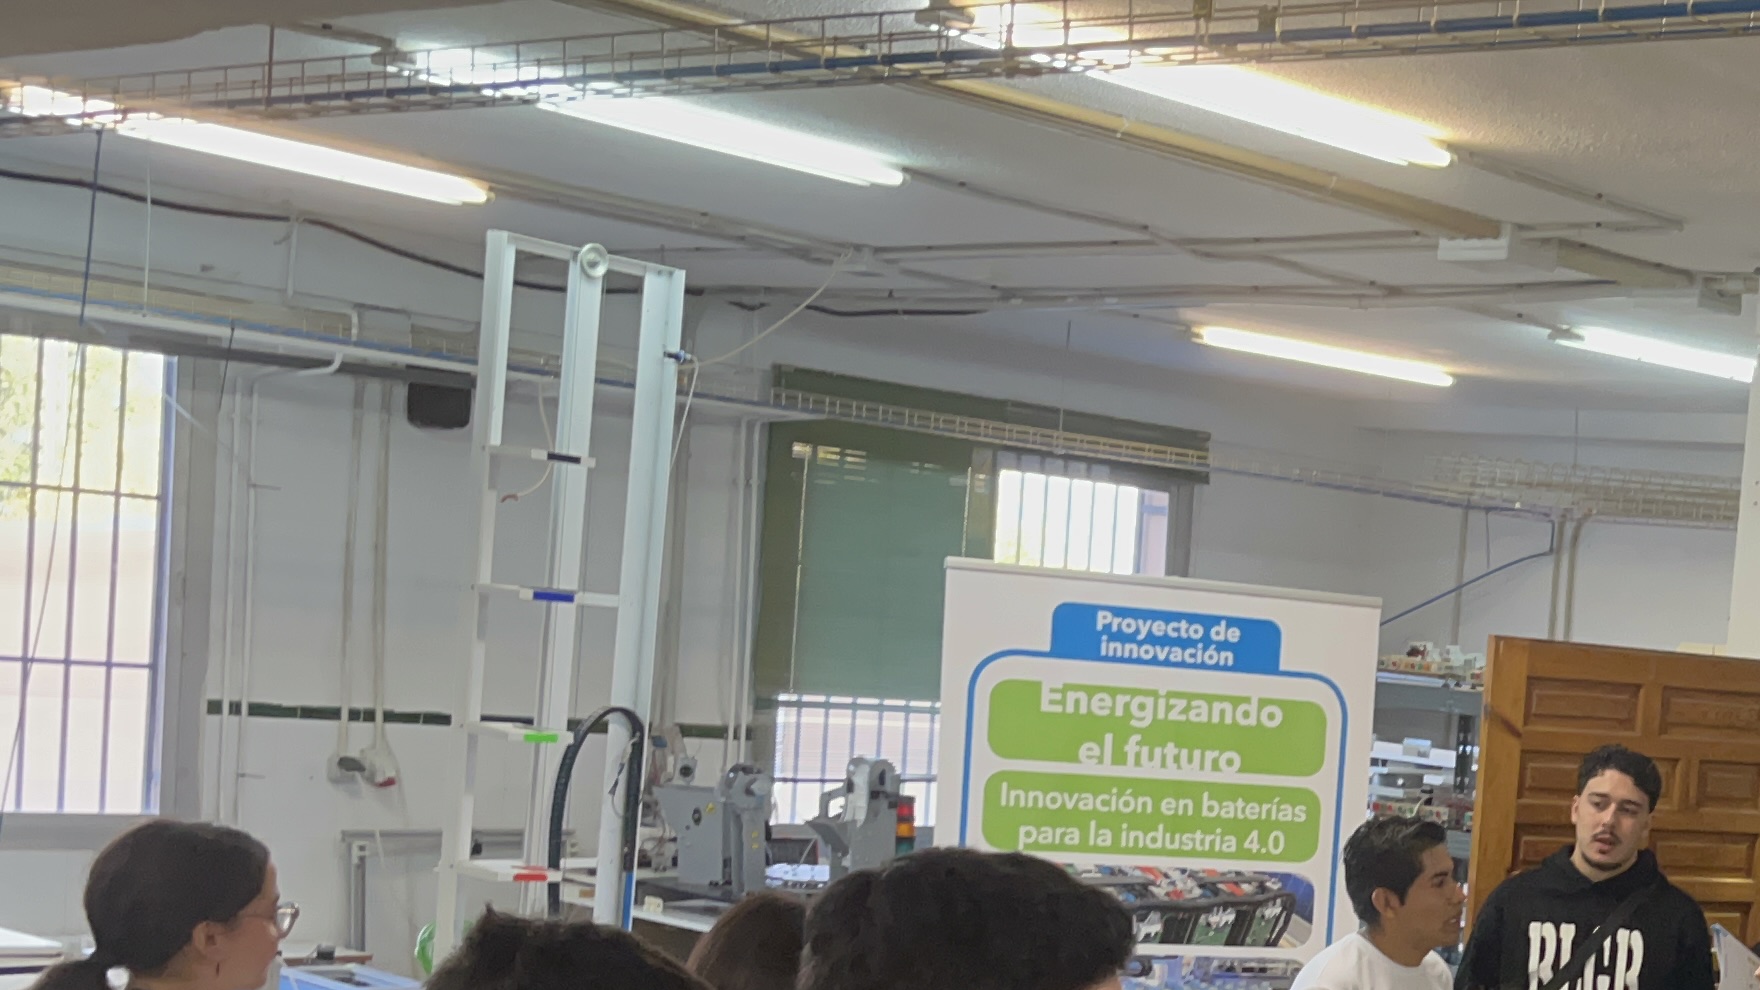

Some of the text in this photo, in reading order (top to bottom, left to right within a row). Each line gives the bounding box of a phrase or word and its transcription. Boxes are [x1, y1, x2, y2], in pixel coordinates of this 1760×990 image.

[1096, 610, 1241, 643] Proyecto de
[1100, 635, 1234, 667] innovación
[1040, 682, 1284, 728] Energizando
[1078, 733, 1242, 773] el futuro
[1000, 781, 1307, 823] Innovación en baterías
[1018, 819, 1285, 855] para la industria 4.0
